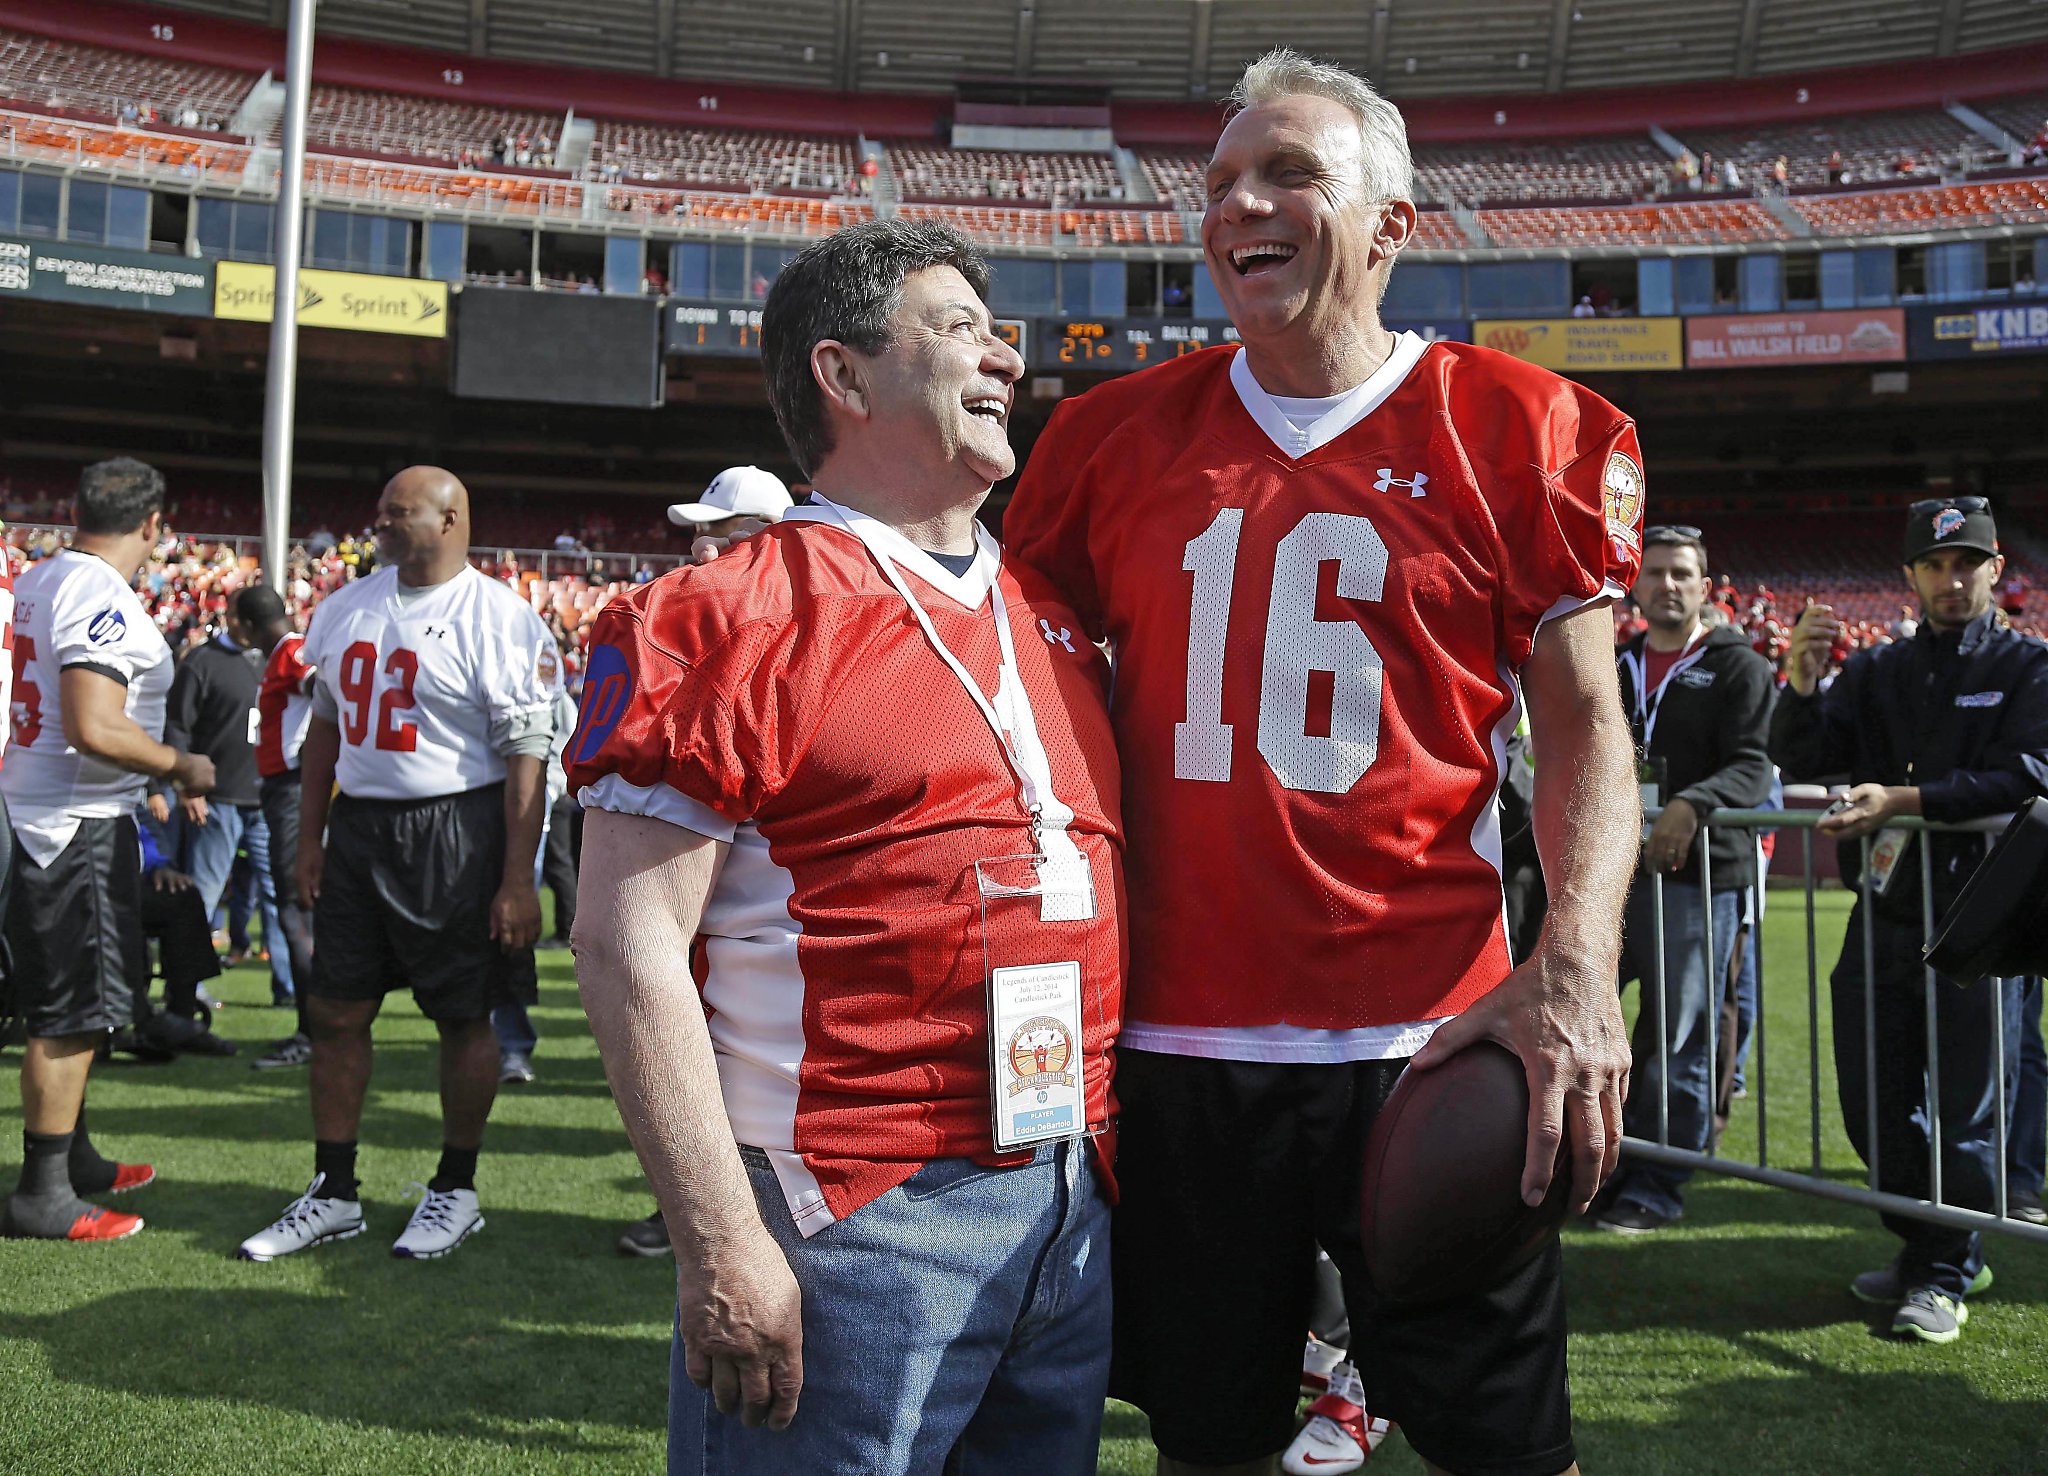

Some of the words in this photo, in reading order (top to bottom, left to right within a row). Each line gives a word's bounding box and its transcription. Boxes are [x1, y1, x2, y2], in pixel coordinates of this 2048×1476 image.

[151, 24, 175, 41] 15
[442, 69, 464, 85] 13
[697, 96, 718, 111] 11
[35, 256, 96, 275] DEVCON
[97, 264, 205, 289] CONSTRUCTION
[65, 273, 176, 296] INCORPORATED
[220, 282, 275, 307] Sprin
[341, 292, 408, 318] Sprint
[676, 307, 718, 324] DOWN
[728, 309, 747, 326] TO
[748, 311, 763, 326] G
[1977, 306, 2048, 339] KNB
[1161, 325, 1190, 341] BALL
[1191, 326, 1209, 341] ON
[1567, 325, 1649, 336] INSURANCE
[1727, 322, 1785, 335] WELCOME
[1789, 321, 1805, 333] TO
[1059, 337, 1093, 362] 27
[1135, 342, 1147, 361] 3
[1567, 338, 1620, 349] TRAVEL
[1691, 339, 1727, 359] BILL
[1729, 336, 1792, 357] WALSH
[1796, 334, 1843, 354] FIELD
[1567, 351, 1606, 363] ROAD
[1612, 351, 1670, 363] SERVICE
[89, 606, 126, 646] hp
[1174, 507, 1389, 794] 16
[340, 641, 419, 752] 92
[1002, 977, 1027, 987] Legends
[1036, 973, 1069, 982] Candlestick
[1014, 993, 1048, 1003] Candlestick
[1030, 1110, 1055, 1119] PLAYER
[1016, 1125, 1036, 1135] Eddie
[1037, 1119, 1071, 1131] DeBartolo
